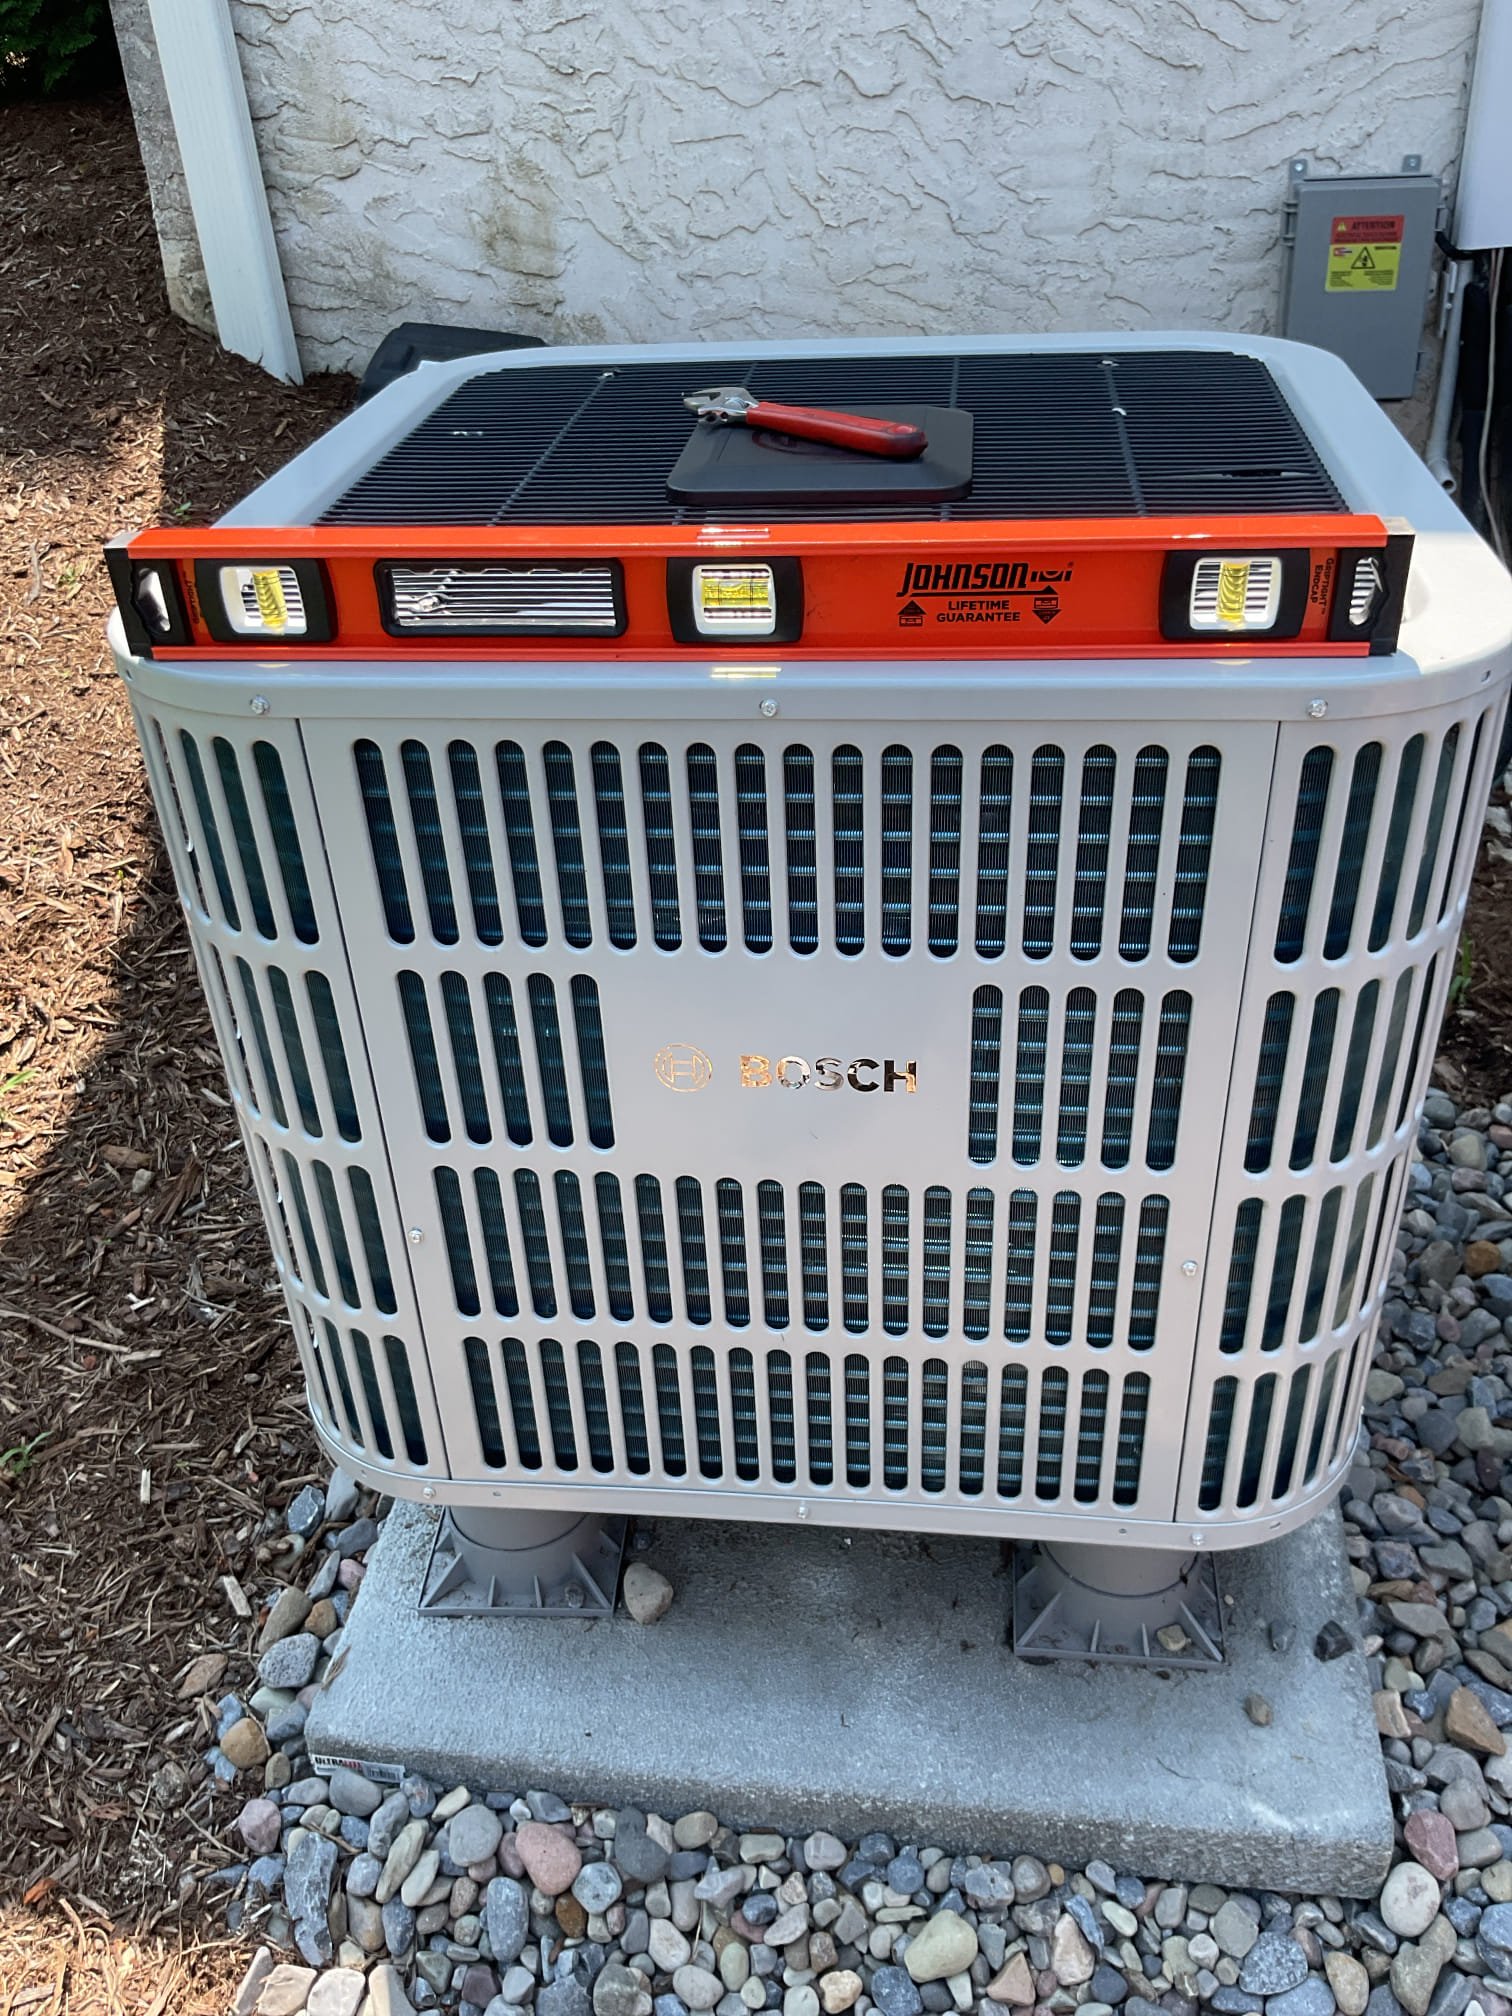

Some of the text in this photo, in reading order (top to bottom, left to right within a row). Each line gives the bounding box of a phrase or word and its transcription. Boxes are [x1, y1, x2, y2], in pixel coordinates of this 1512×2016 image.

[896, 562, 1029, 597] JOHNSON
[936, 612, 1021, 623] GUARANTEE
[948, 600, 1010, 612] LIFETIME
[739, 1055, 917, 1093] BOSCH
